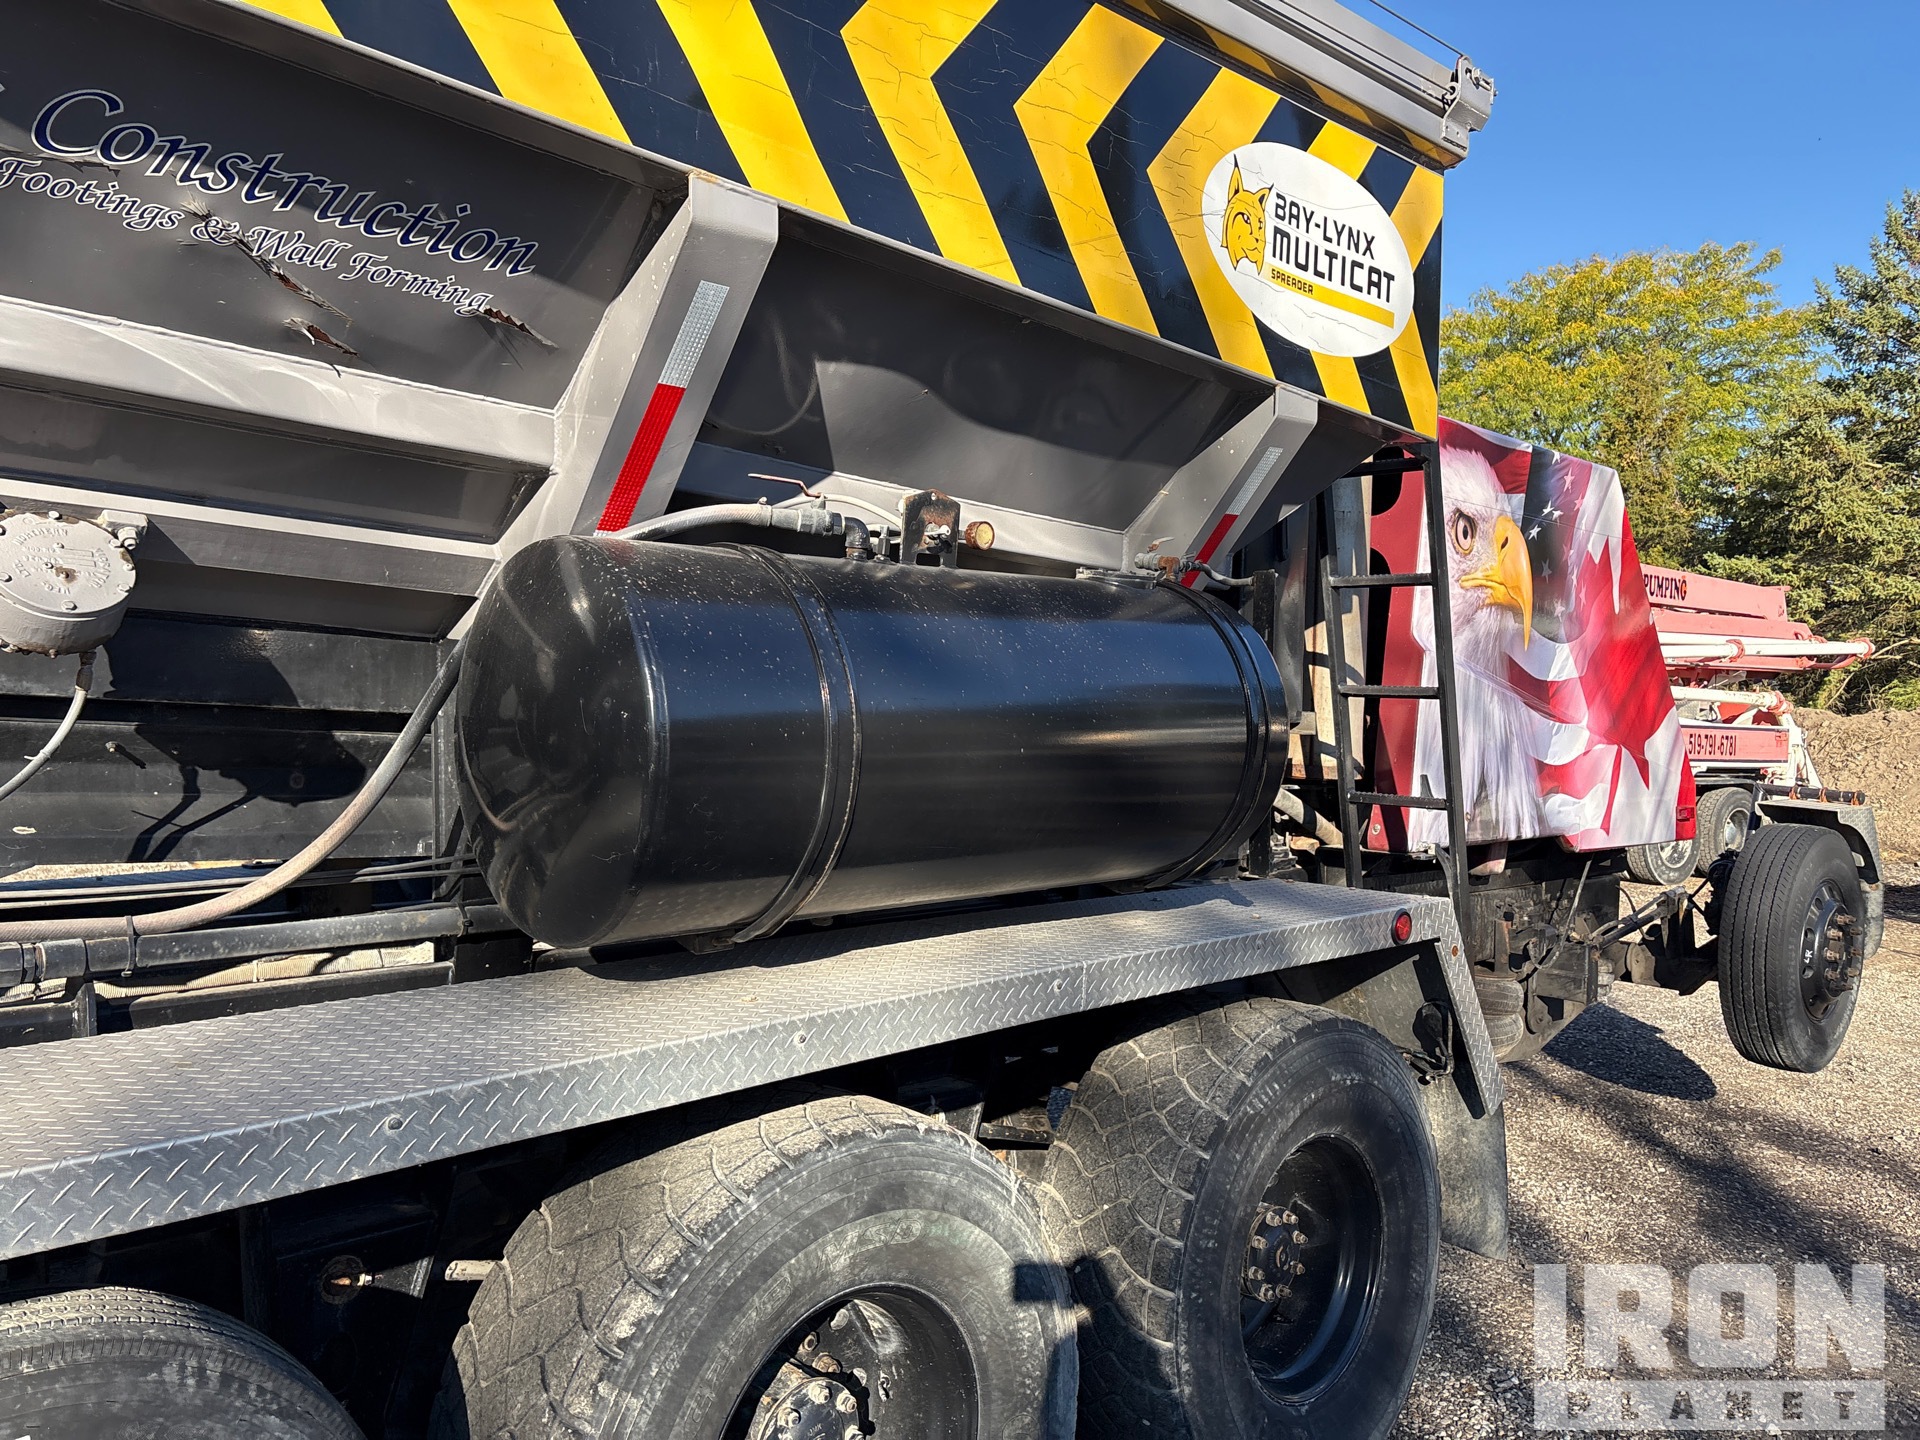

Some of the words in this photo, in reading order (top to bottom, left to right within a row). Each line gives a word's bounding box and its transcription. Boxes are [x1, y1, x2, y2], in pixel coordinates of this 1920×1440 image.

[31, 89, 538, 277] Construction
[0, 157, 185, 231] Footings
[190, 216, 241, 245] &
[247, 226, 352, 271] Wall
[338, 252, 494, 317] Forming
[1274, 192, 1376, 260] BAY-LYNX
[1271, 225, 1395, 304] MULTICAT
[1271, 268, 1314, 296] SPREADER
[1643, 574, 1687, 601] PUMPING
[1688, 733, 1737, 756] 519-791-6781
